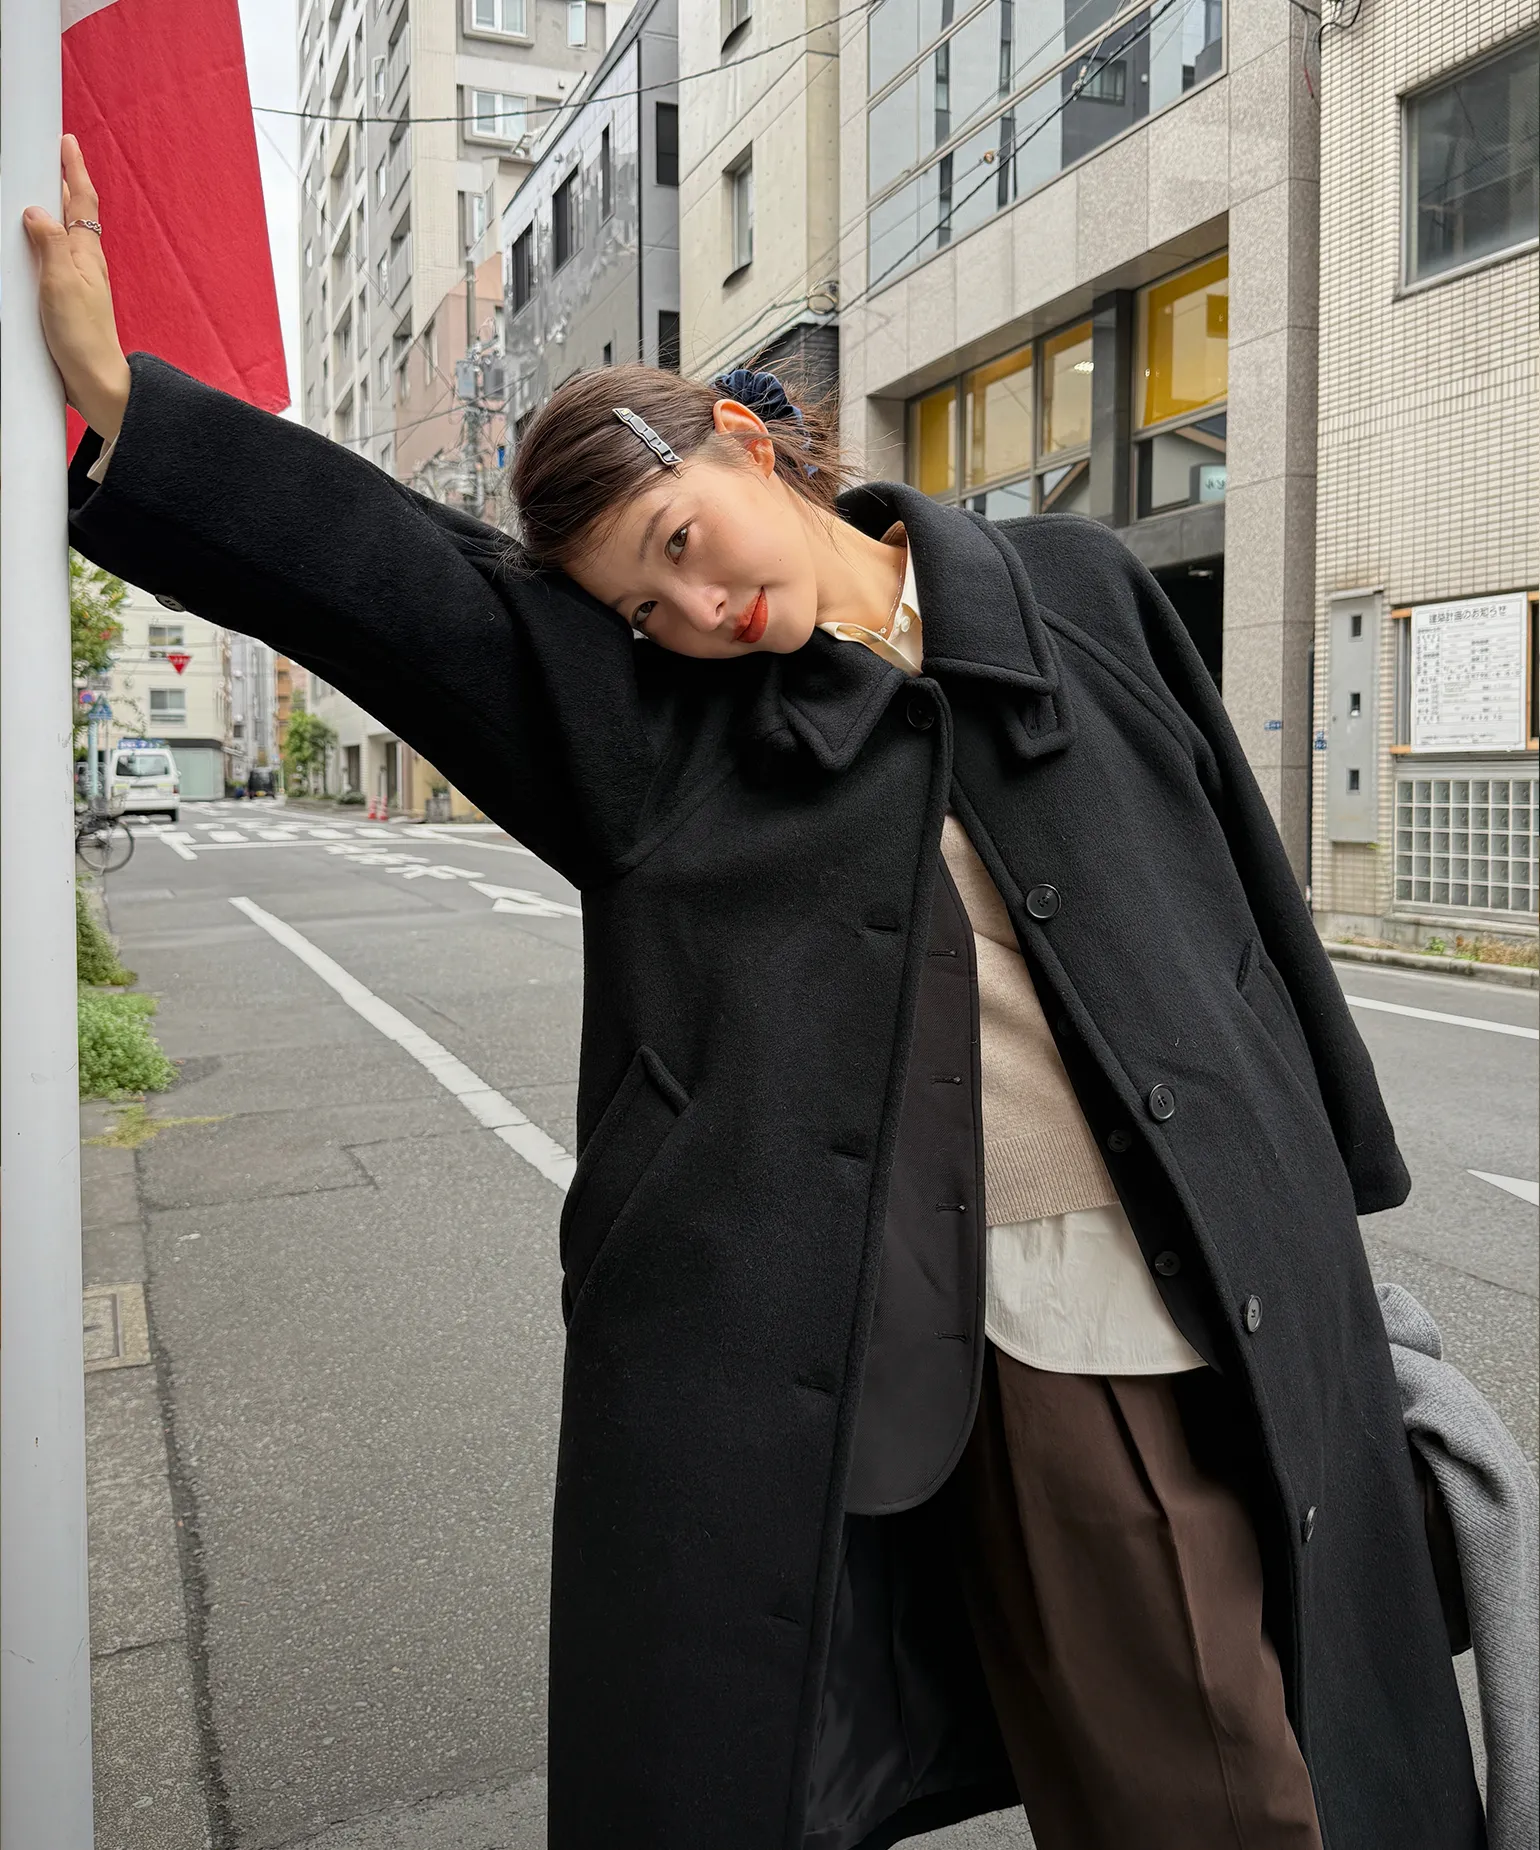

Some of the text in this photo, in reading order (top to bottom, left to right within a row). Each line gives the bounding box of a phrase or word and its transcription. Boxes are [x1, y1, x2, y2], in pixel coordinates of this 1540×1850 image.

[1429, 605, 1507, 624] 建築計画のお知らせ
